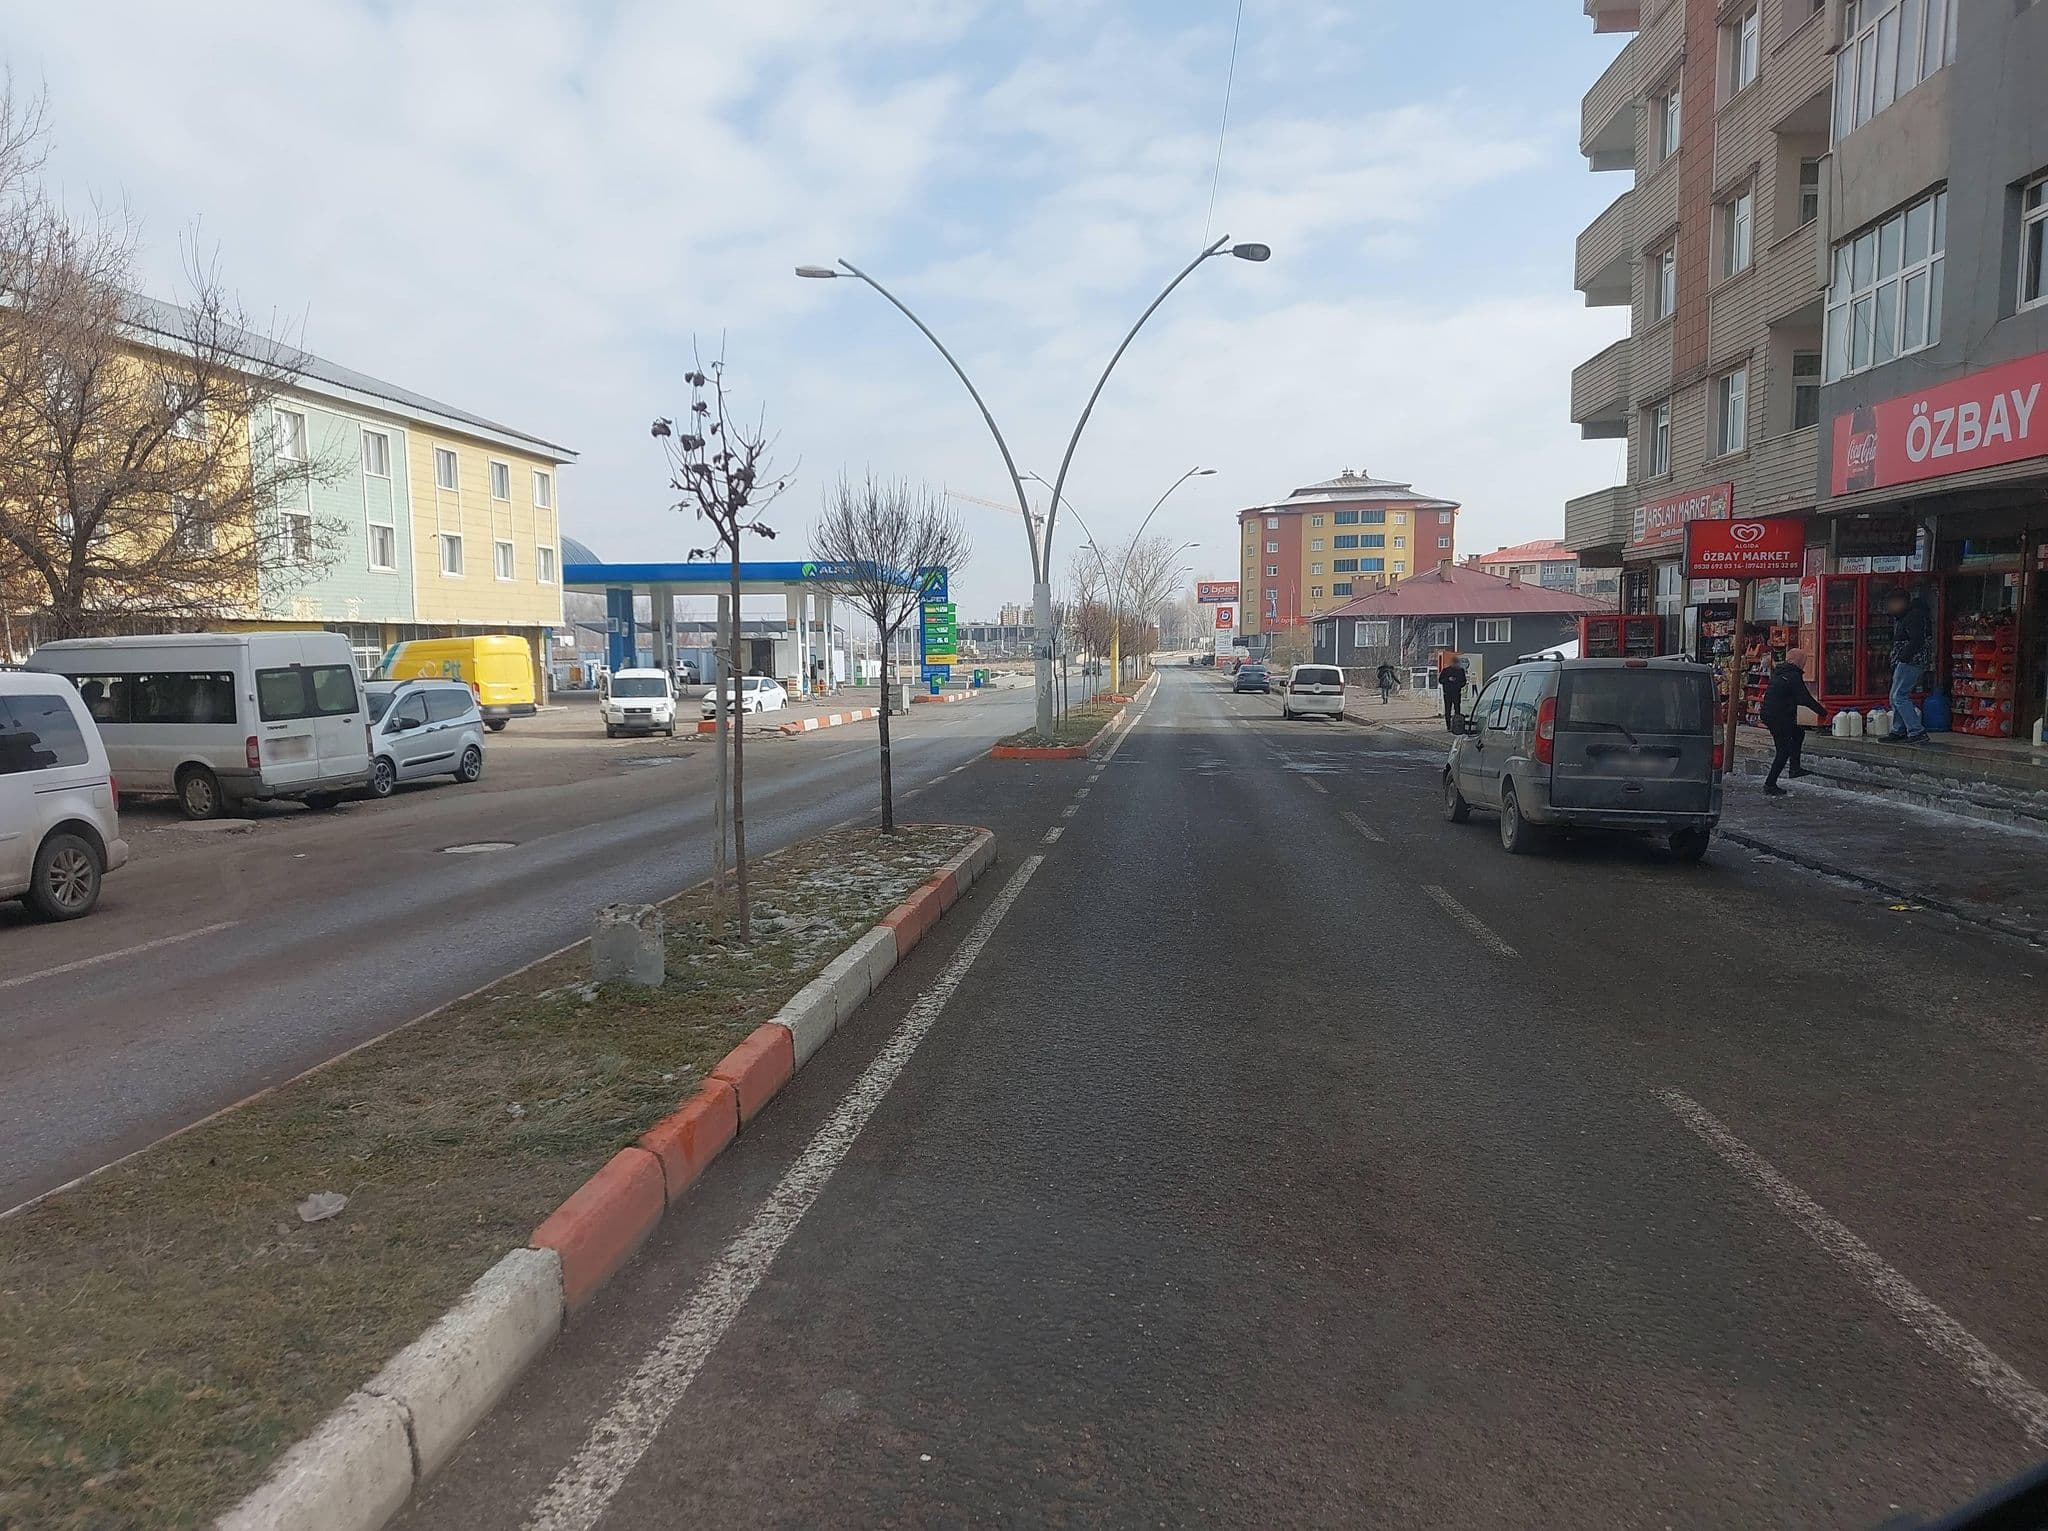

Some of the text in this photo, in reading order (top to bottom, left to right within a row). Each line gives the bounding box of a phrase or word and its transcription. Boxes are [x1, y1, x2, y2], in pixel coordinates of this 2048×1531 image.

[1906, 383, 2041, 463] ÖZBAY
[1647, 504, 1676, 529] ARSLAN
[1677, 495, 1711, 523] MARKET
[1703, 550, 1790, 562] ÖZBAY MARKET
[1211, 584, 1237, 595] bpet
[442, 659, 462, 678] Ptt
